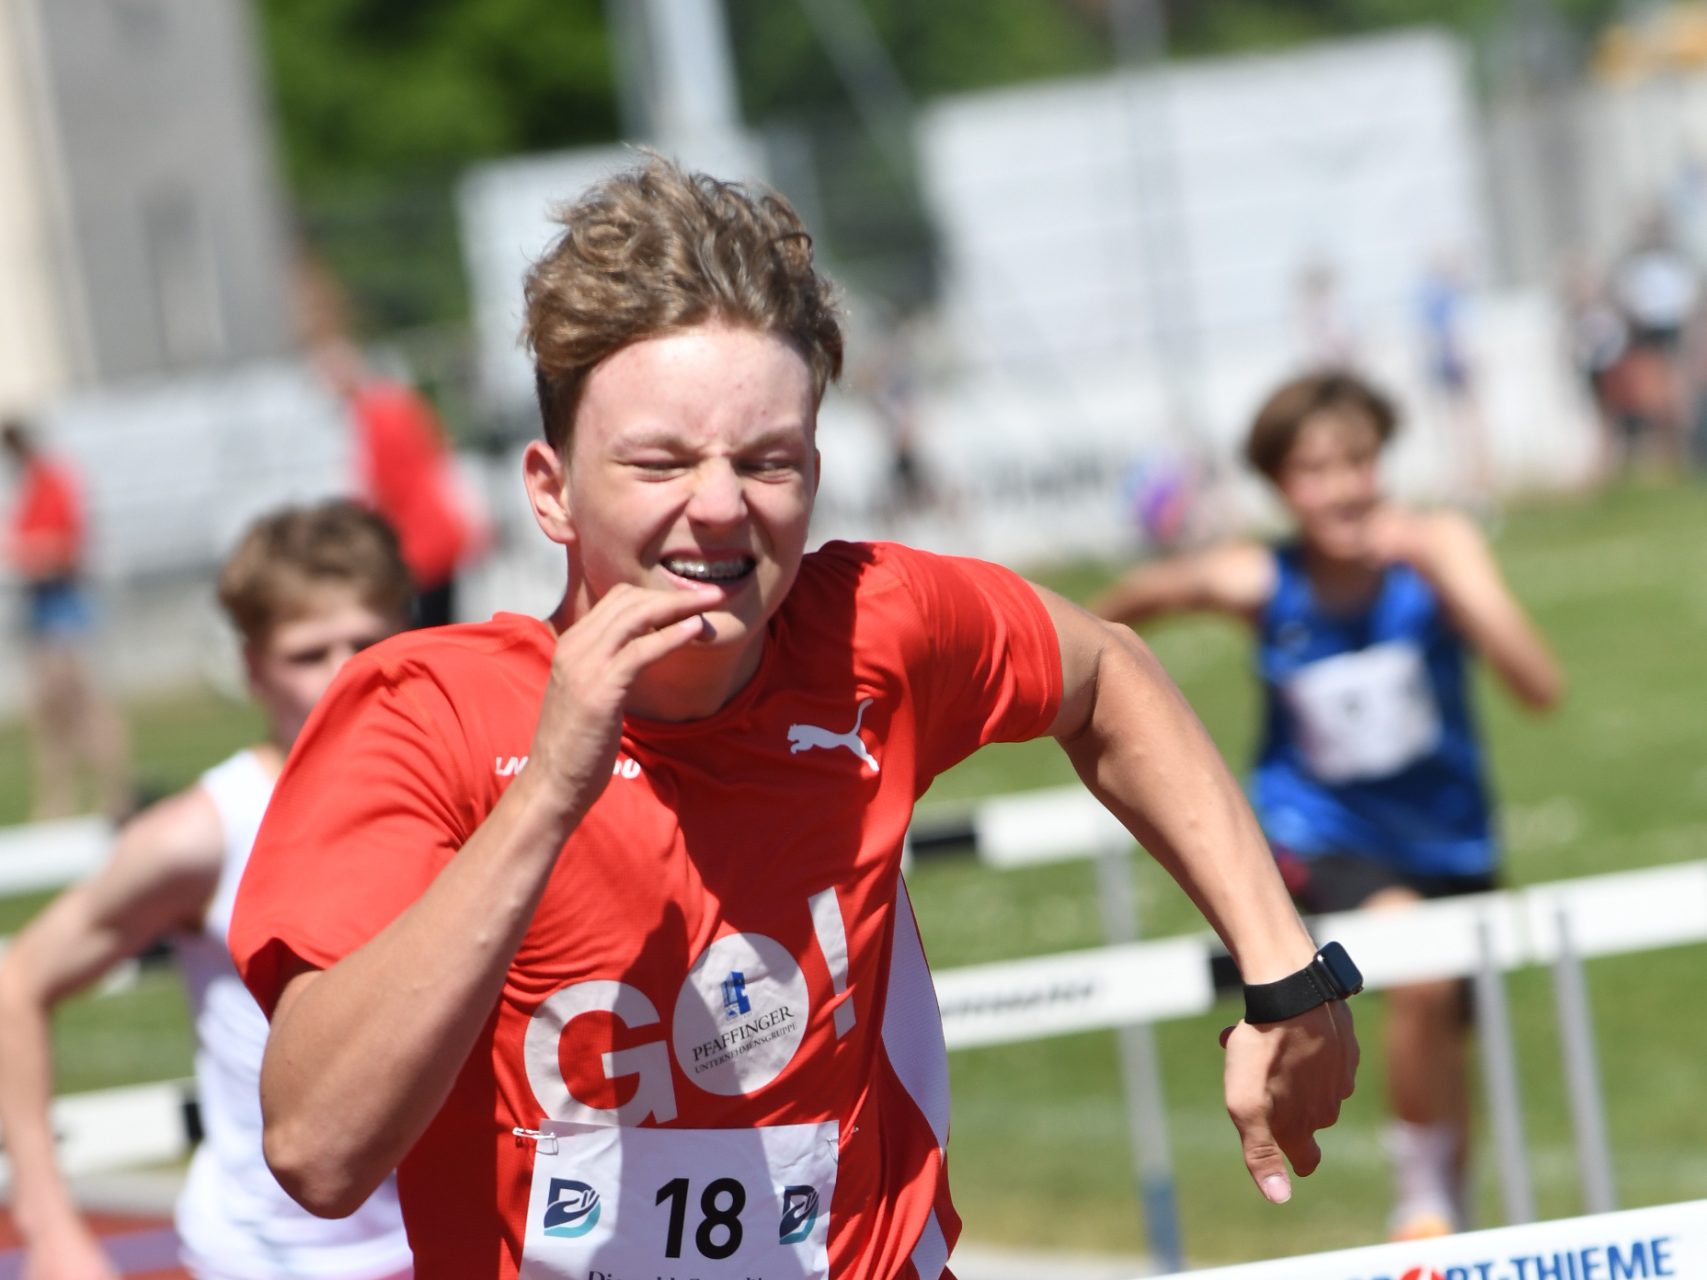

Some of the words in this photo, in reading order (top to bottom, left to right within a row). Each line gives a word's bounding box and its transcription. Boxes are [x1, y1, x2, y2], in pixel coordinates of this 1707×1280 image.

[691, 1005, 796, 1062] PFAFFINGER
[694, 1022, 798, 1074] UNTERNEHMENSGRUPPE
[655, 1177, 747, 1260] 18
